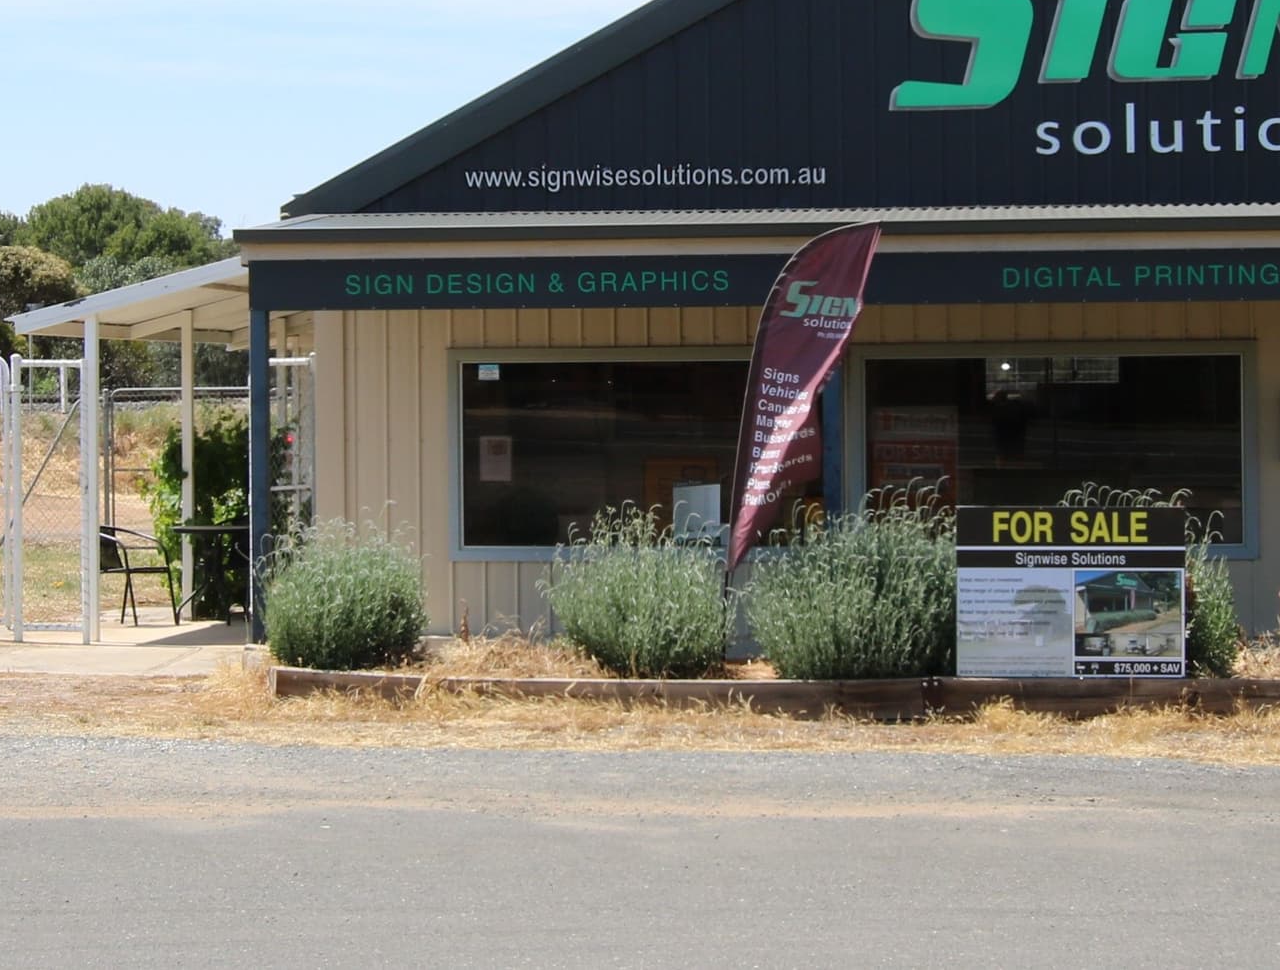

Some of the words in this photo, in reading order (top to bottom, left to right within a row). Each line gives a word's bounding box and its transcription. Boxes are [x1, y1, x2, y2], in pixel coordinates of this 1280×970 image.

[465, 163, 827, 193] www.signwisesolutions.com.au
[346, 274, 413, 296] SIGN
[426, 272, 535, 295] DESIGN
[548, 272, 564, 294] &
[577, 270, 729, 293] GRAPHICS
[1002, 266, 1121, 288] DIGITAL
[1135, 263, 1280, 286] PRINTING
[763, 367, 800, 384] Signs
[992, 511, 1053, 543] FOR
[1070, 511, 1148, 543] SALE
[1015, 553, 1068, 567] Signwise
[1072, 553, 1126, 565] Solutions
[1114, 663, 1150, 674] $75,000
[1160, 663, 1180, 674] SAV
